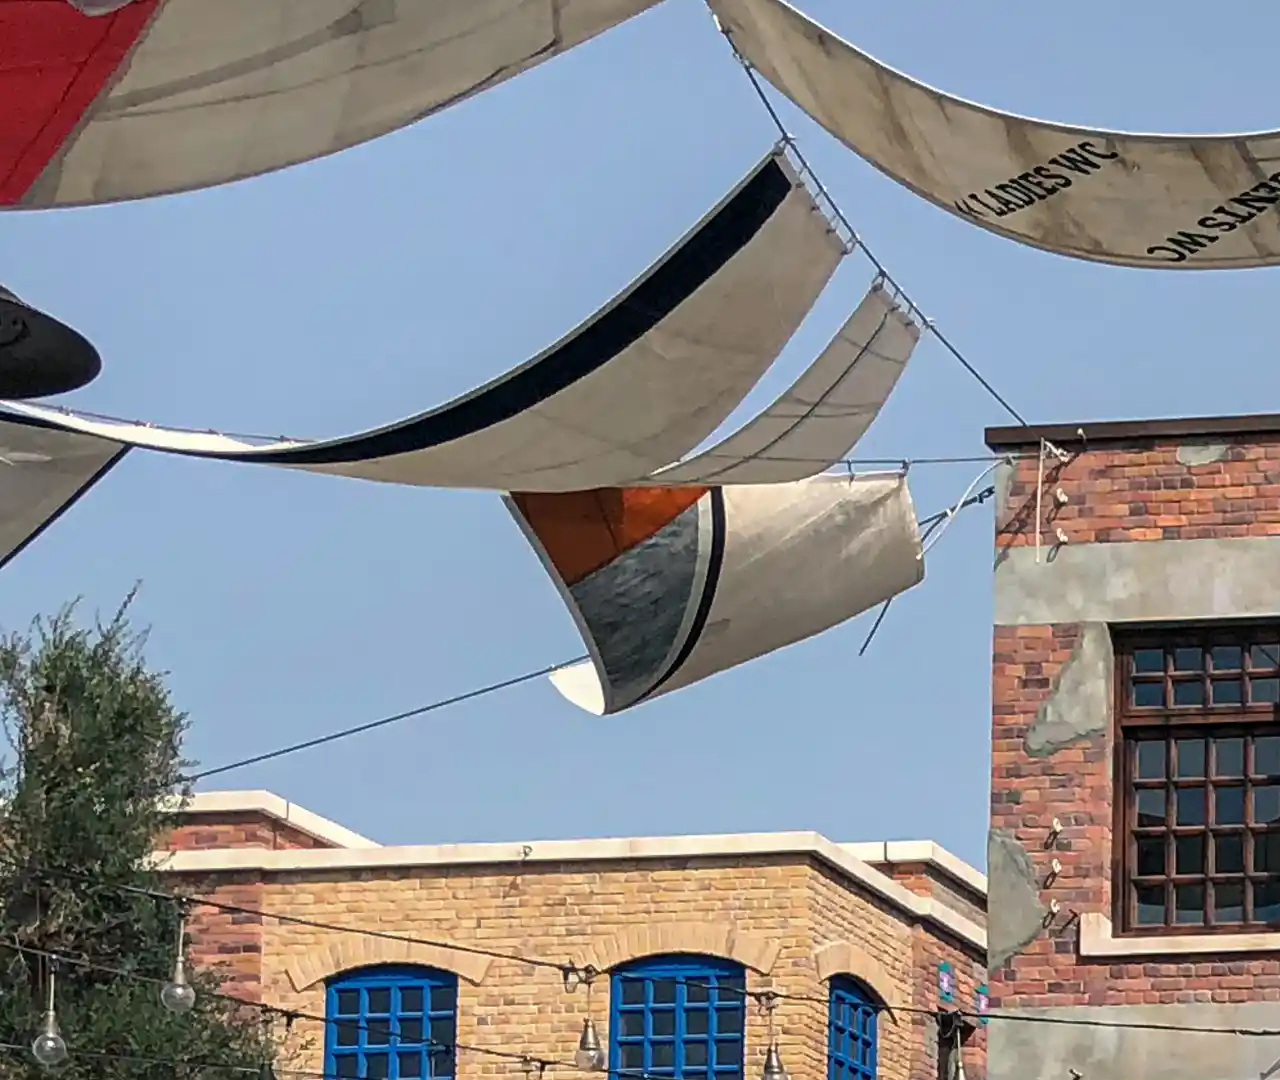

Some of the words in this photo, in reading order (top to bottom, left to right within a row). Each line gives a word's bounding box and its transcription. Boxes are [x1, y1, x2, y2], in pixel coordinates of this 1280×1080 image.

[968, 166, 1072, 217] LADIES
[1048, 141, 1119, 175] WC
[1146, 231, 1219, 262] WC
